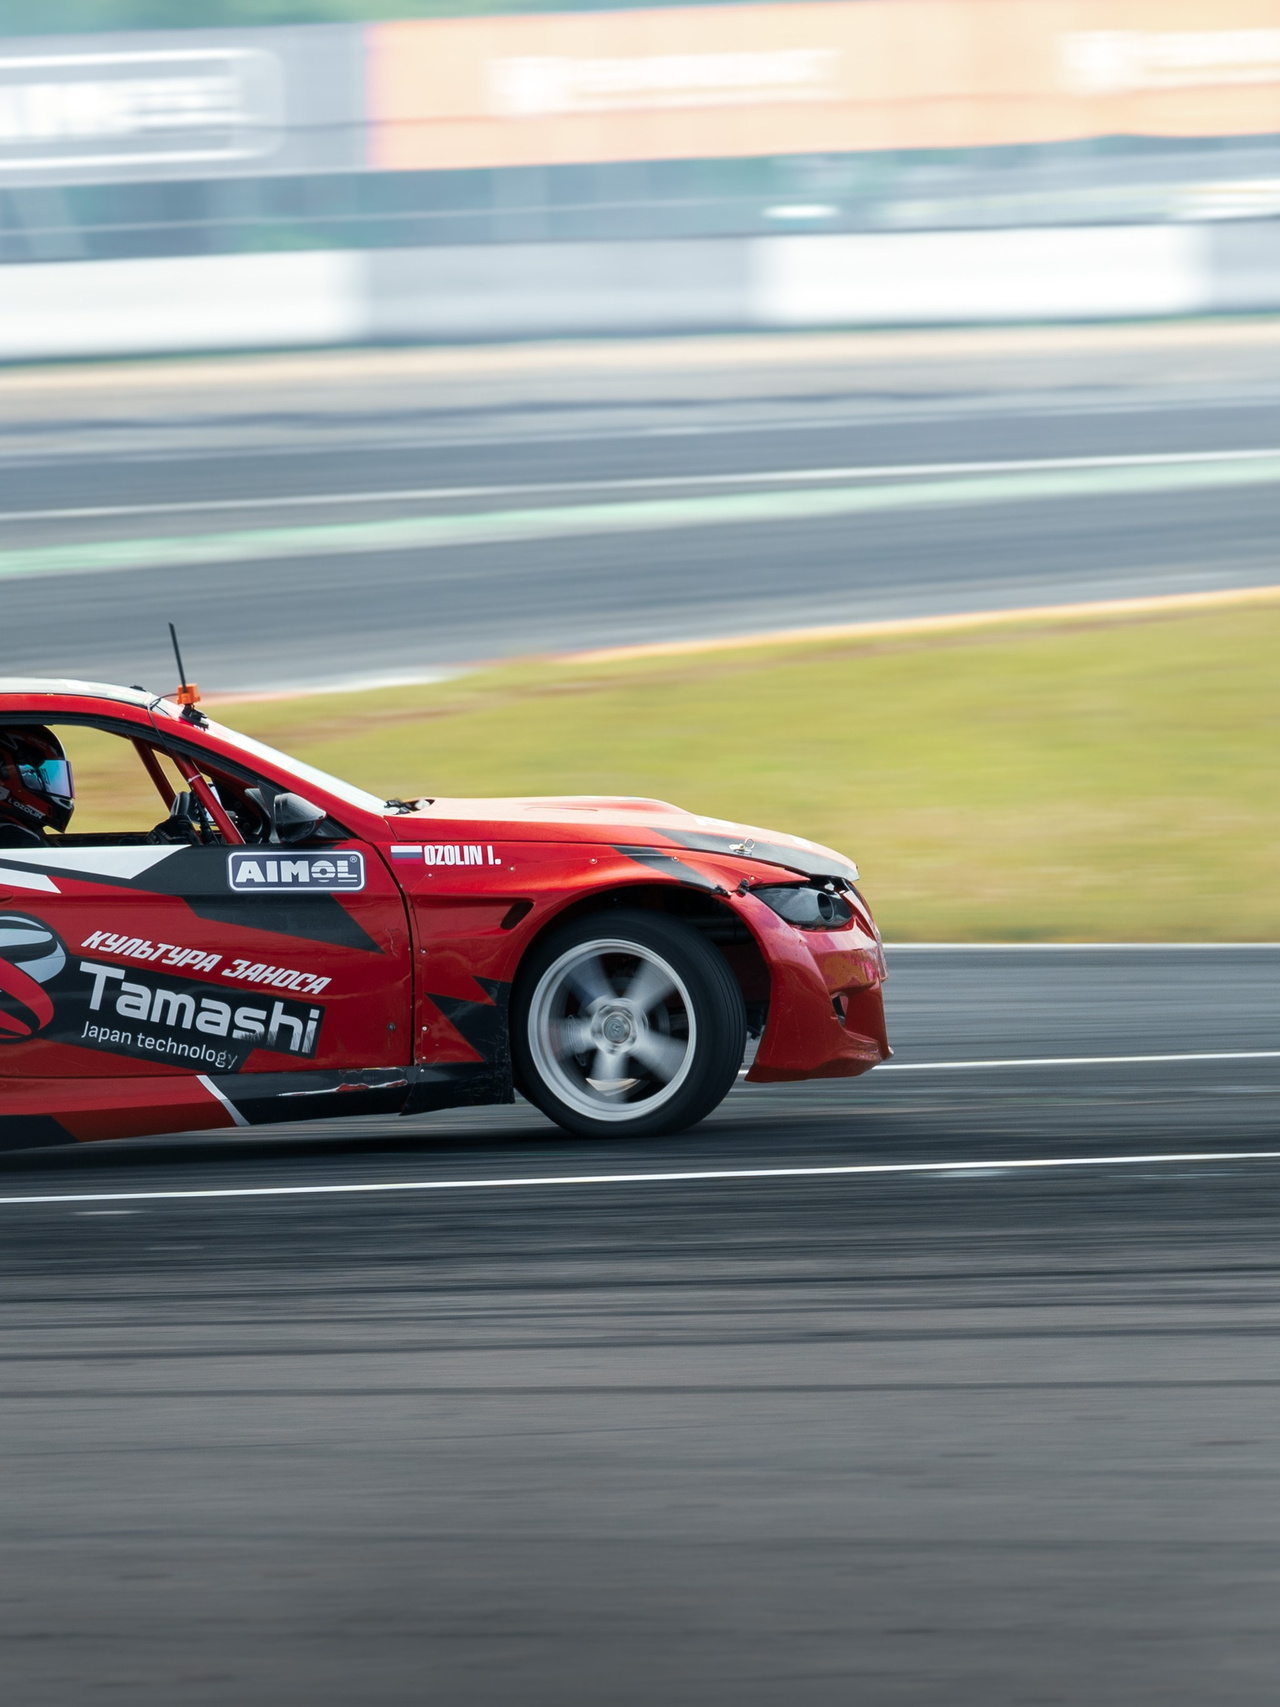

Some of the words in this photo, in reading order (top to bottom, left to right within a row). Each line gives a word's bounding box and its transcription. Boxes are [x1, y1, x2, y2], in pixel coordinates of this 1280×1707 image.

[424, 845, 483, 865] OZOLIN
[487, 845, 501, 865] I.
[81, 930, 223, 973] КУЛЬТУРА
[221, 958, 332, 995] ЗАНОСА
[79, 961, 320, 1054] Tamashi
[81, 1021, 132, 1045] Japan
[136, 1031, 239, 1069] technology
